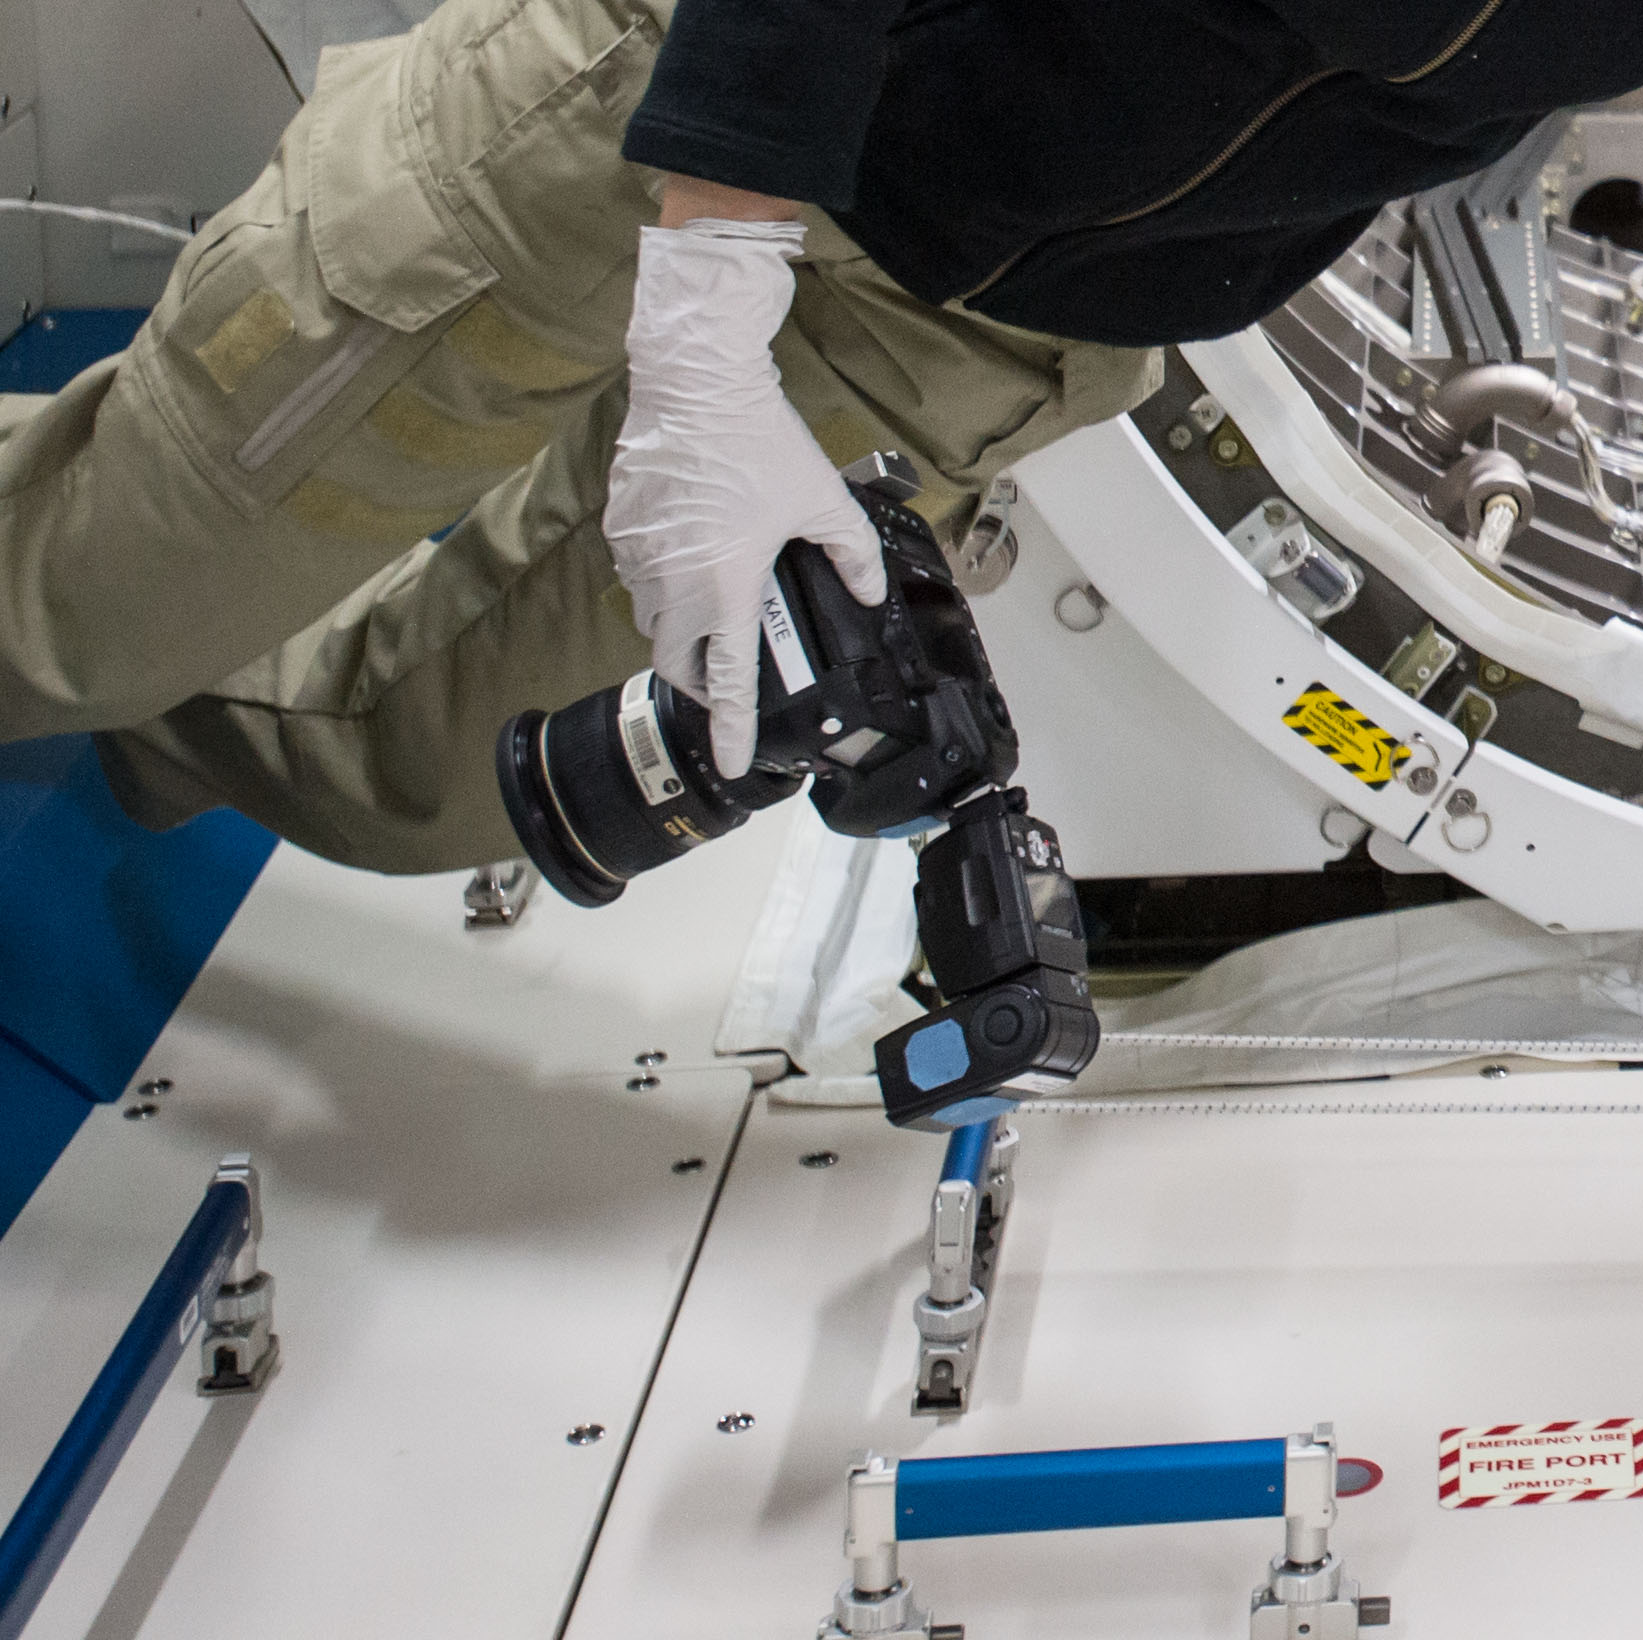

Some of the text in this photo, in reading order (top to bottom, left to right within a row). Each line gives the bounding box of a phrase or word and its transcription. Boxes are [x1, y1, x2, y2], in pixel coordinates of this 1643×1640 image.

[763, 597, 791, 643] KATE
[1315, 700, 1355, 735] CAUTION
[1466, 1433, 1627, 1450] EMERGENCY USE
[1469, 1453, 1626, 1474] FIRE PORT
[1502, 1478, 1593, 1490] JPM1D7-3
